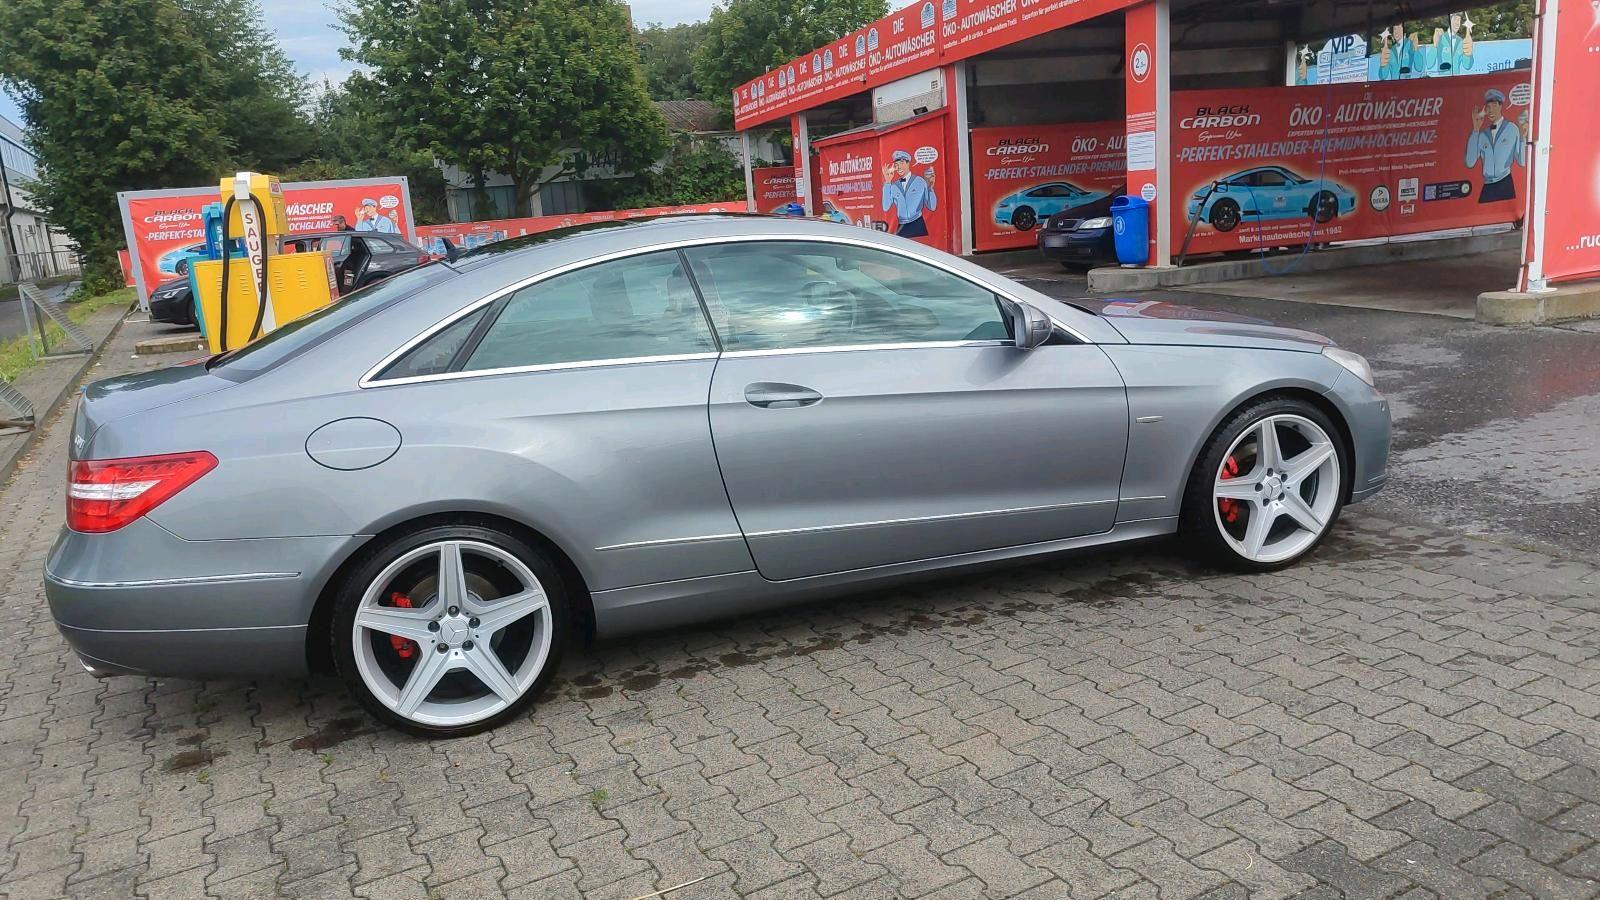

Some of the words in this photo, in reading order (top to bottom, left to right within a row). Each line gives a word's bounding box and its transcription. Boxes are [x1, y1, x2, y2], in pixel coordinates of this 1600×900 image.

[892, 17, 904, 35] DIE
[942, 22, 957, 38] ÖKO
[961, 0, 1017, 31] AUTOWÄSCHER
[838, 43, 849, 59] DIE
[868, 51, 882, 68] ÖKO
[884, 29, 936, 61] AUTOWÄSCHER
[1331, 35, 1354, 54] VIP
[799, 61, 808, 75] DIE
[1486, 59, 1511, 71] sanft
[1196, 105, 1249, 117] BLACK
[1289, 103, 1323, 127] ÖKO
[1333, 97, 1444, 123] AUTOWÄSCHER
[999, 136, 1041, 146] BLACK
[1071, 135, 1097, 153] ÖKO
